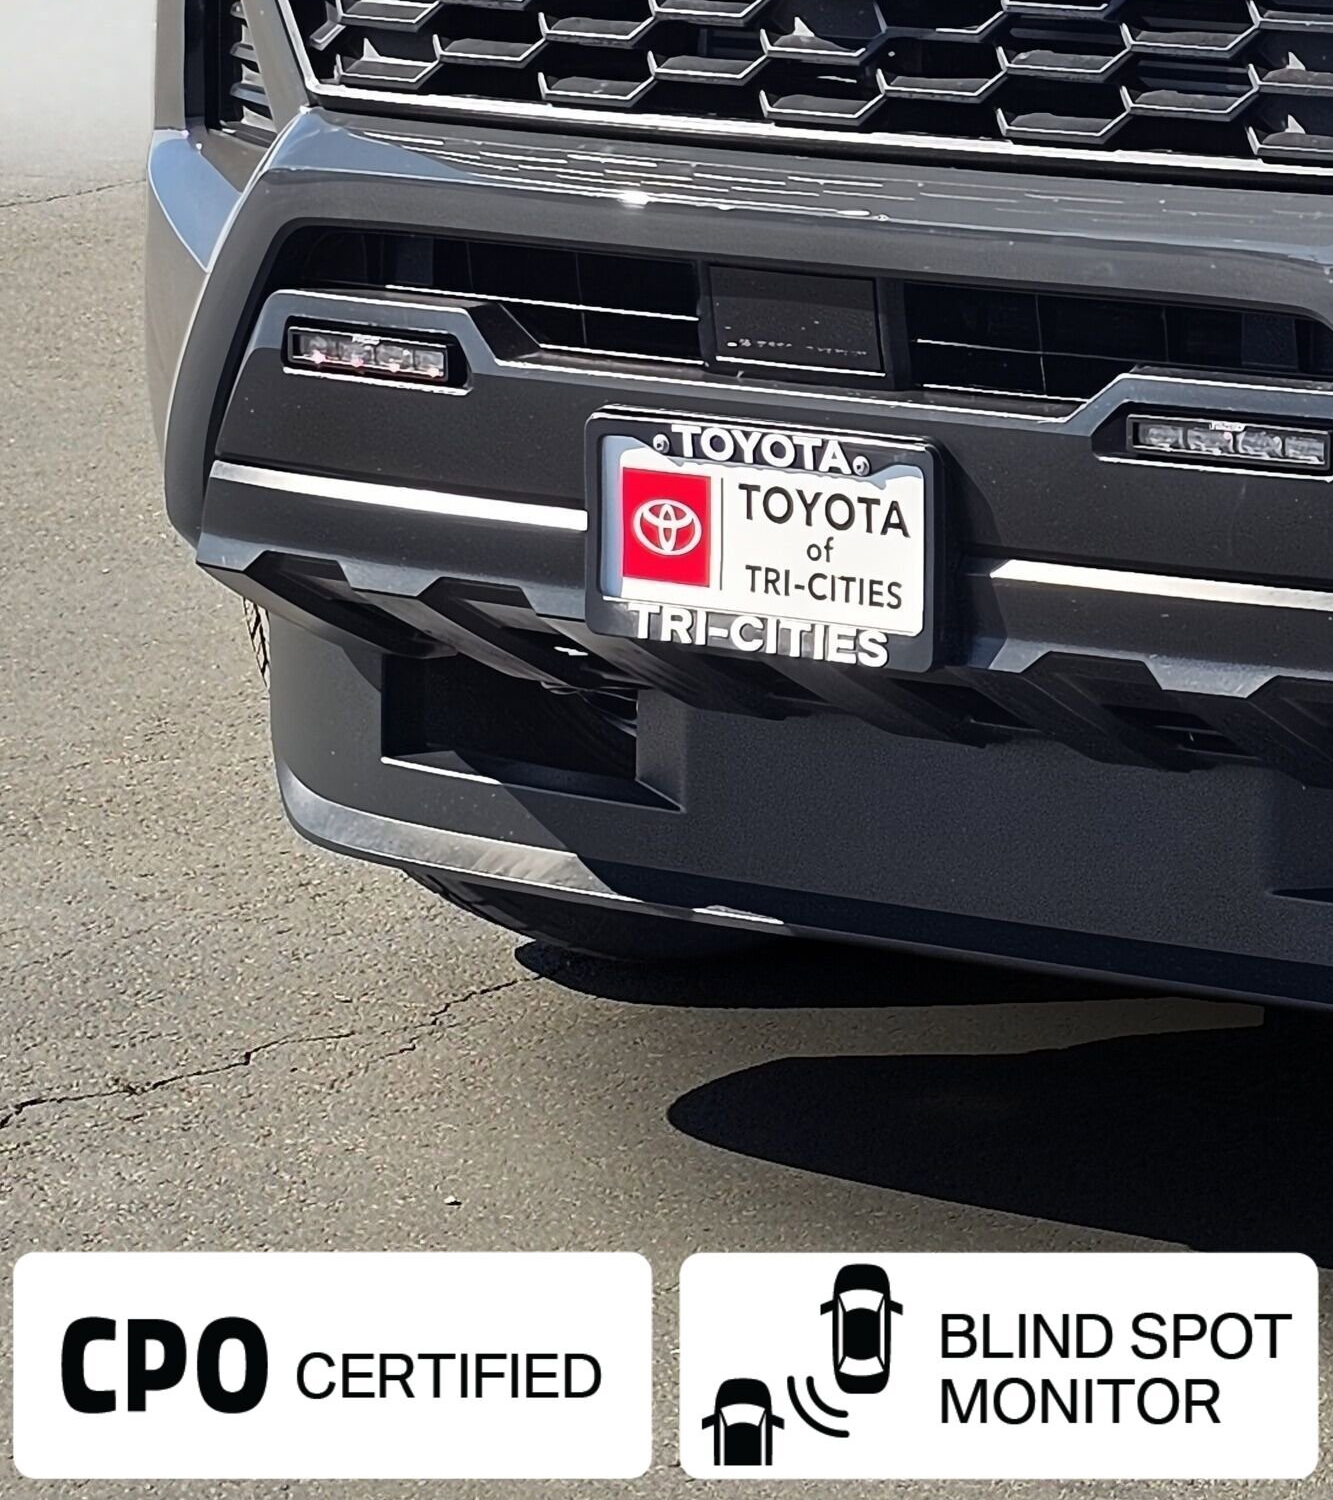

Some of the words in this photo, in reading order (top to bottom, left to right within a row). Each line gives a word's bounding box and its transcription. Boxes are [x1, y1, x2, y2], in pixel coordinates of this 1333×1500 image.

[671, 424, 852, 476] TOYOTA
[738, 483, 911, 538] TOYOTA
[806, 537, 834, 563] of
[745, 565, 903, 610] TRI-CITIES
[628, 603, 889, 669] TRI-CITIES
